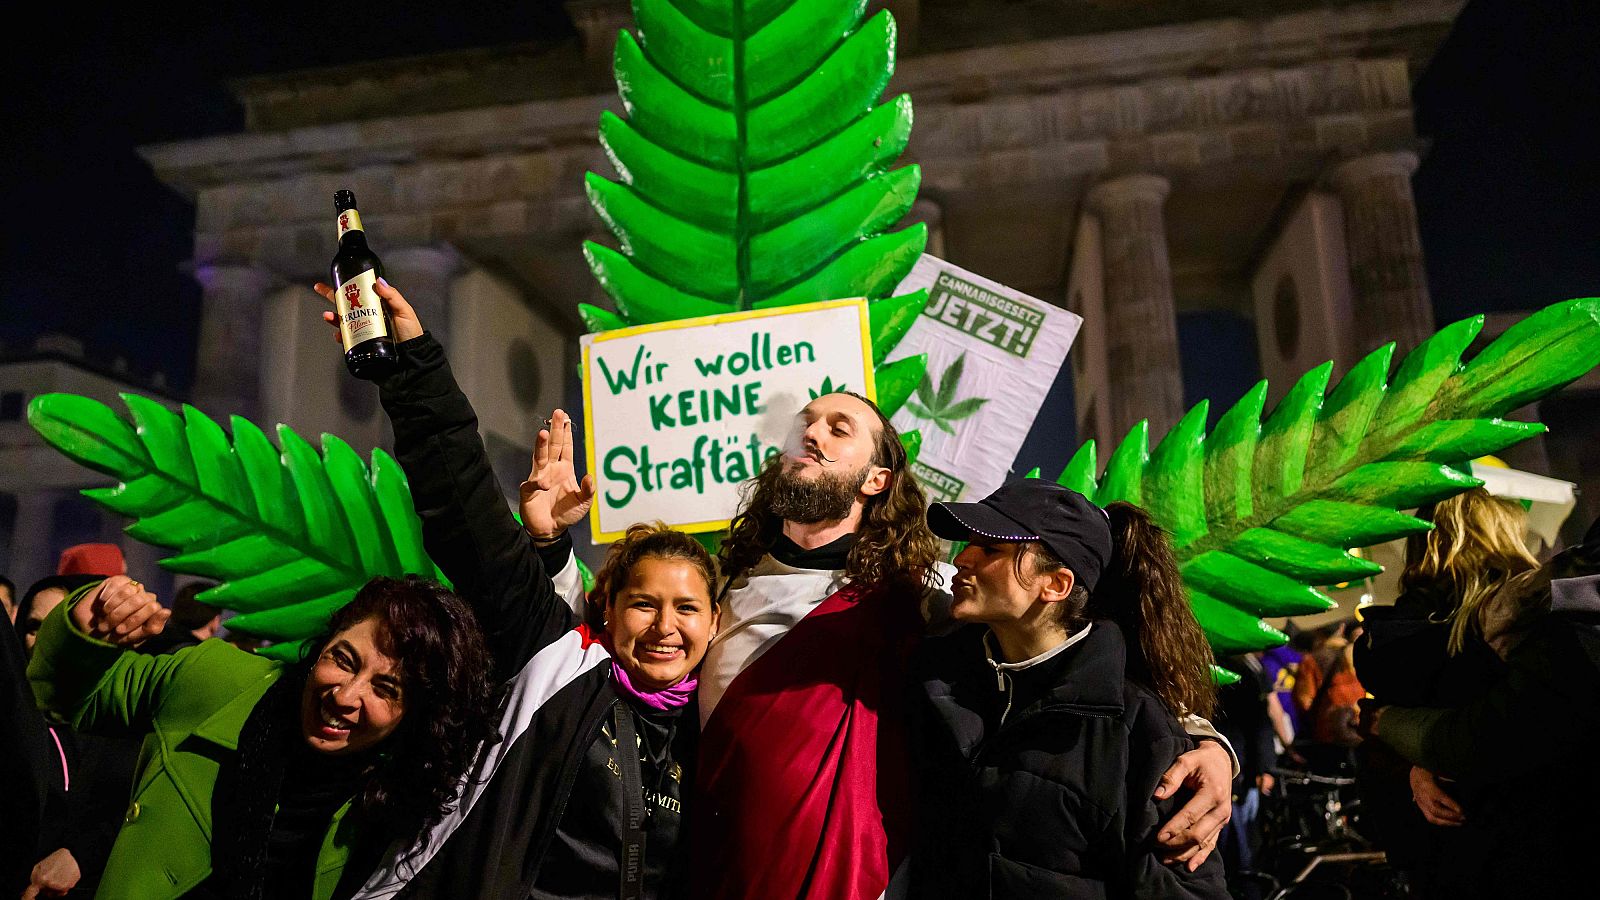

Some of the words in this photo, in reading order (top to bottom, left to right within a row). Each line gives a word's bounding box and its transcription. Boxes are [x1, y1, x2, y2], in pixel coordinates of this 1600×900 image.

[924, 292, 1033, 354] JETZT!
[939, 275, 1041, 325] CANNABISGESETZ
[597, 344, 669, 396] Wir
[695, 332, 816, 377] wollen
[649, 381, 762, 431] KEINE
[627, 843, 640, 882] PUMA
